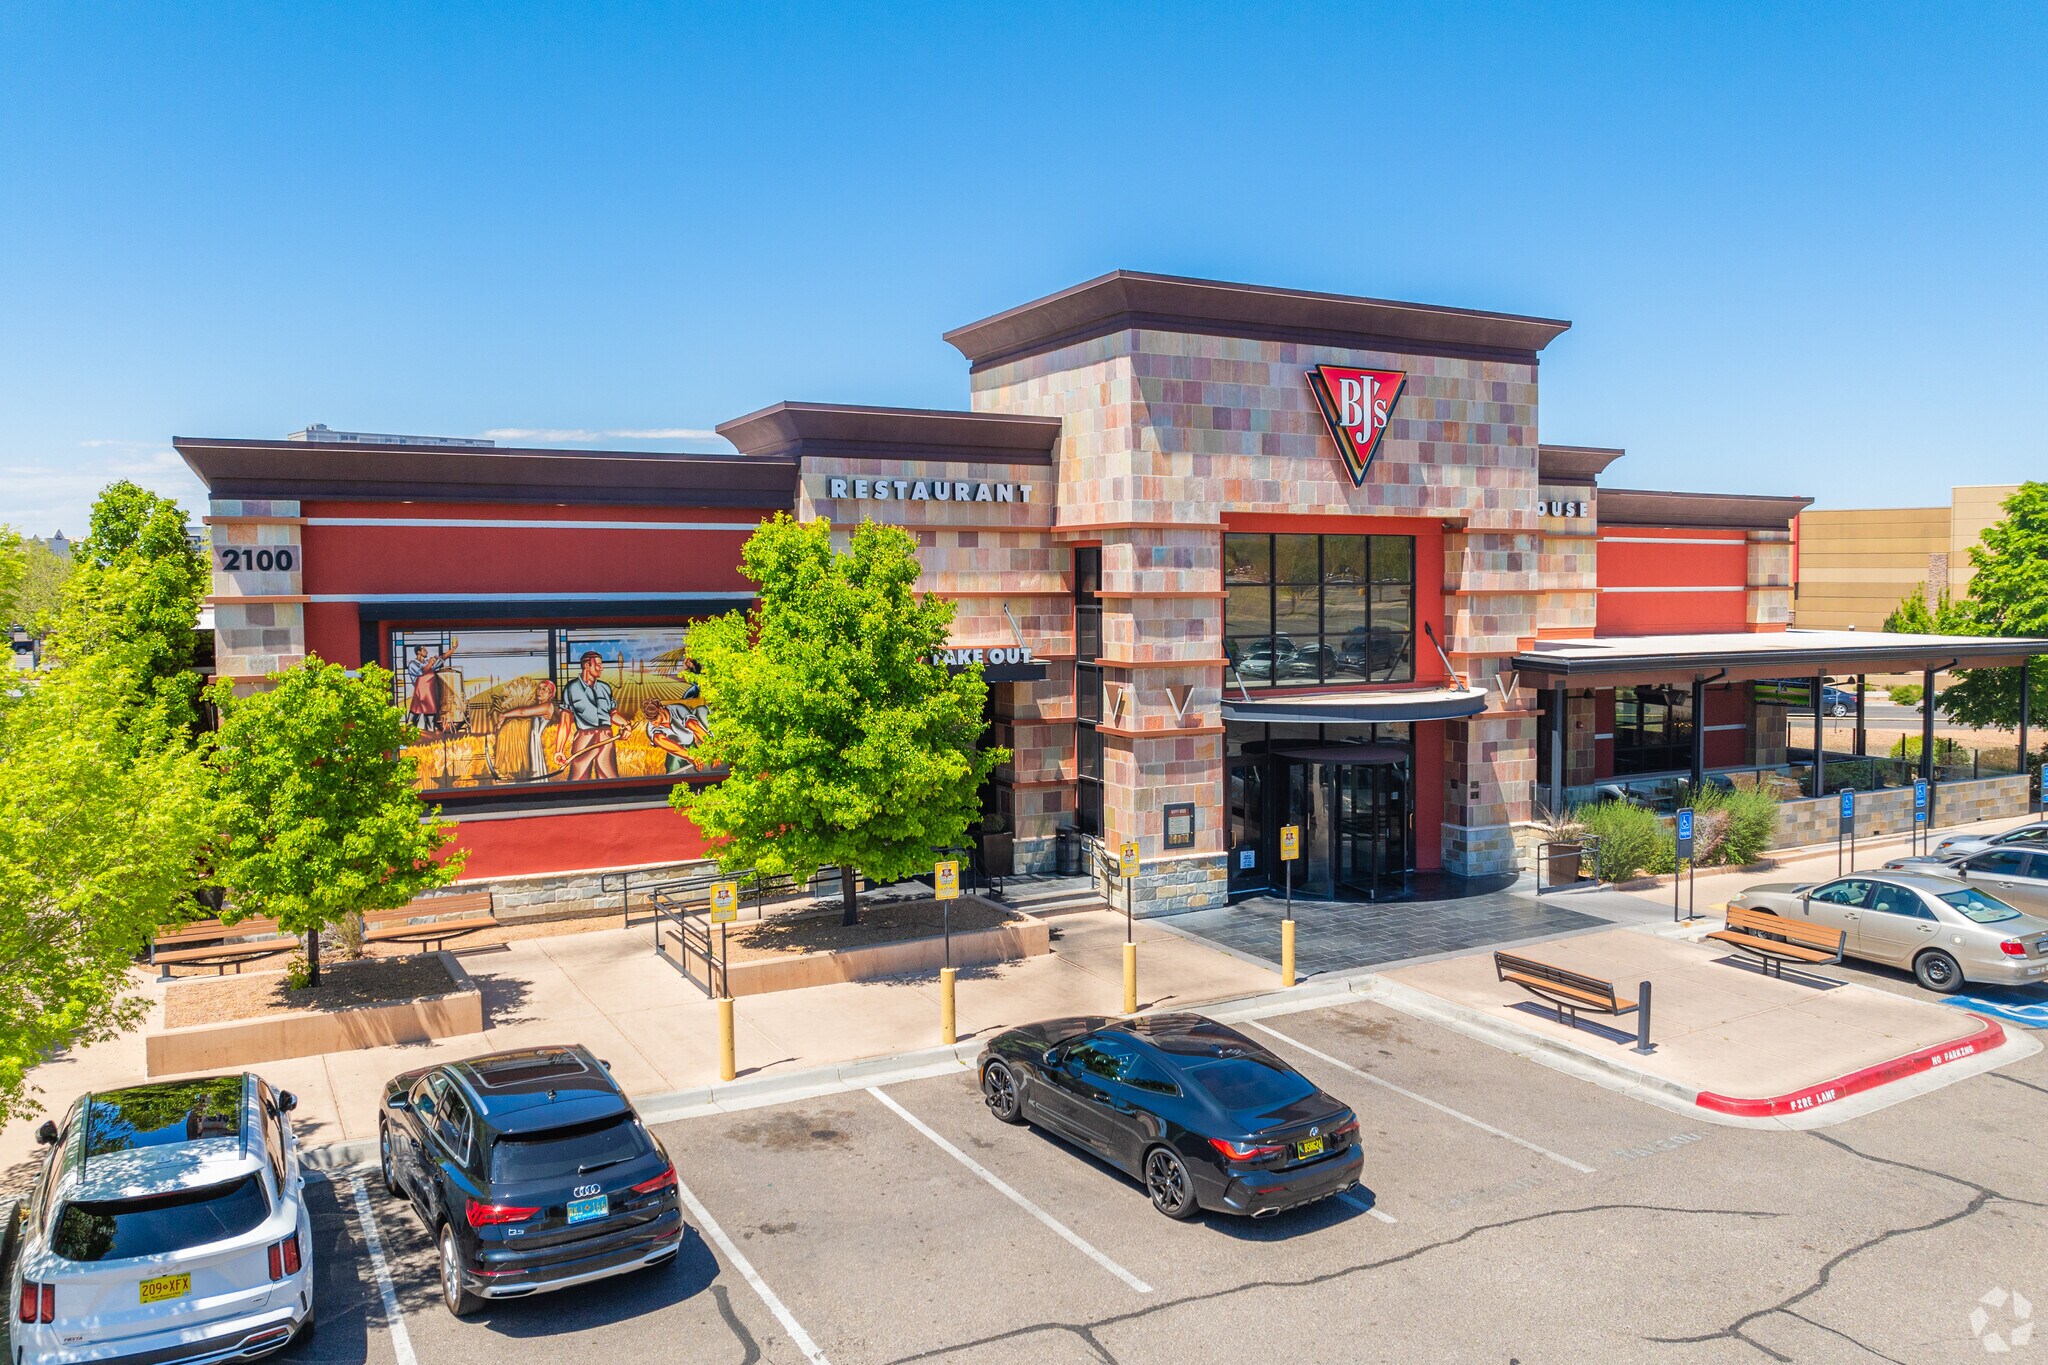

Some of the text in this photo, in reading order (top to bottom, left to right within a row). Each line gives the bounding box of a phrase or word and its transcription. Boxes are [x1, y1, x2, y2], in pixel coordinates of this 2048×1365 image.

[1338, 375, 1388, 445] BJ's
[829, 478, 1033, 503] RESTAURANT
[222, 549, 293, 571] 2100
[988, 648, 1032, 665] OUT
[1931, 1044, 1974, 1066] NO PARKING
[1790, 1096, 1813, 1111] FIRE
[142, 1282, 162, 1297] 209
[169, 1277, 189, 1292] XFX
